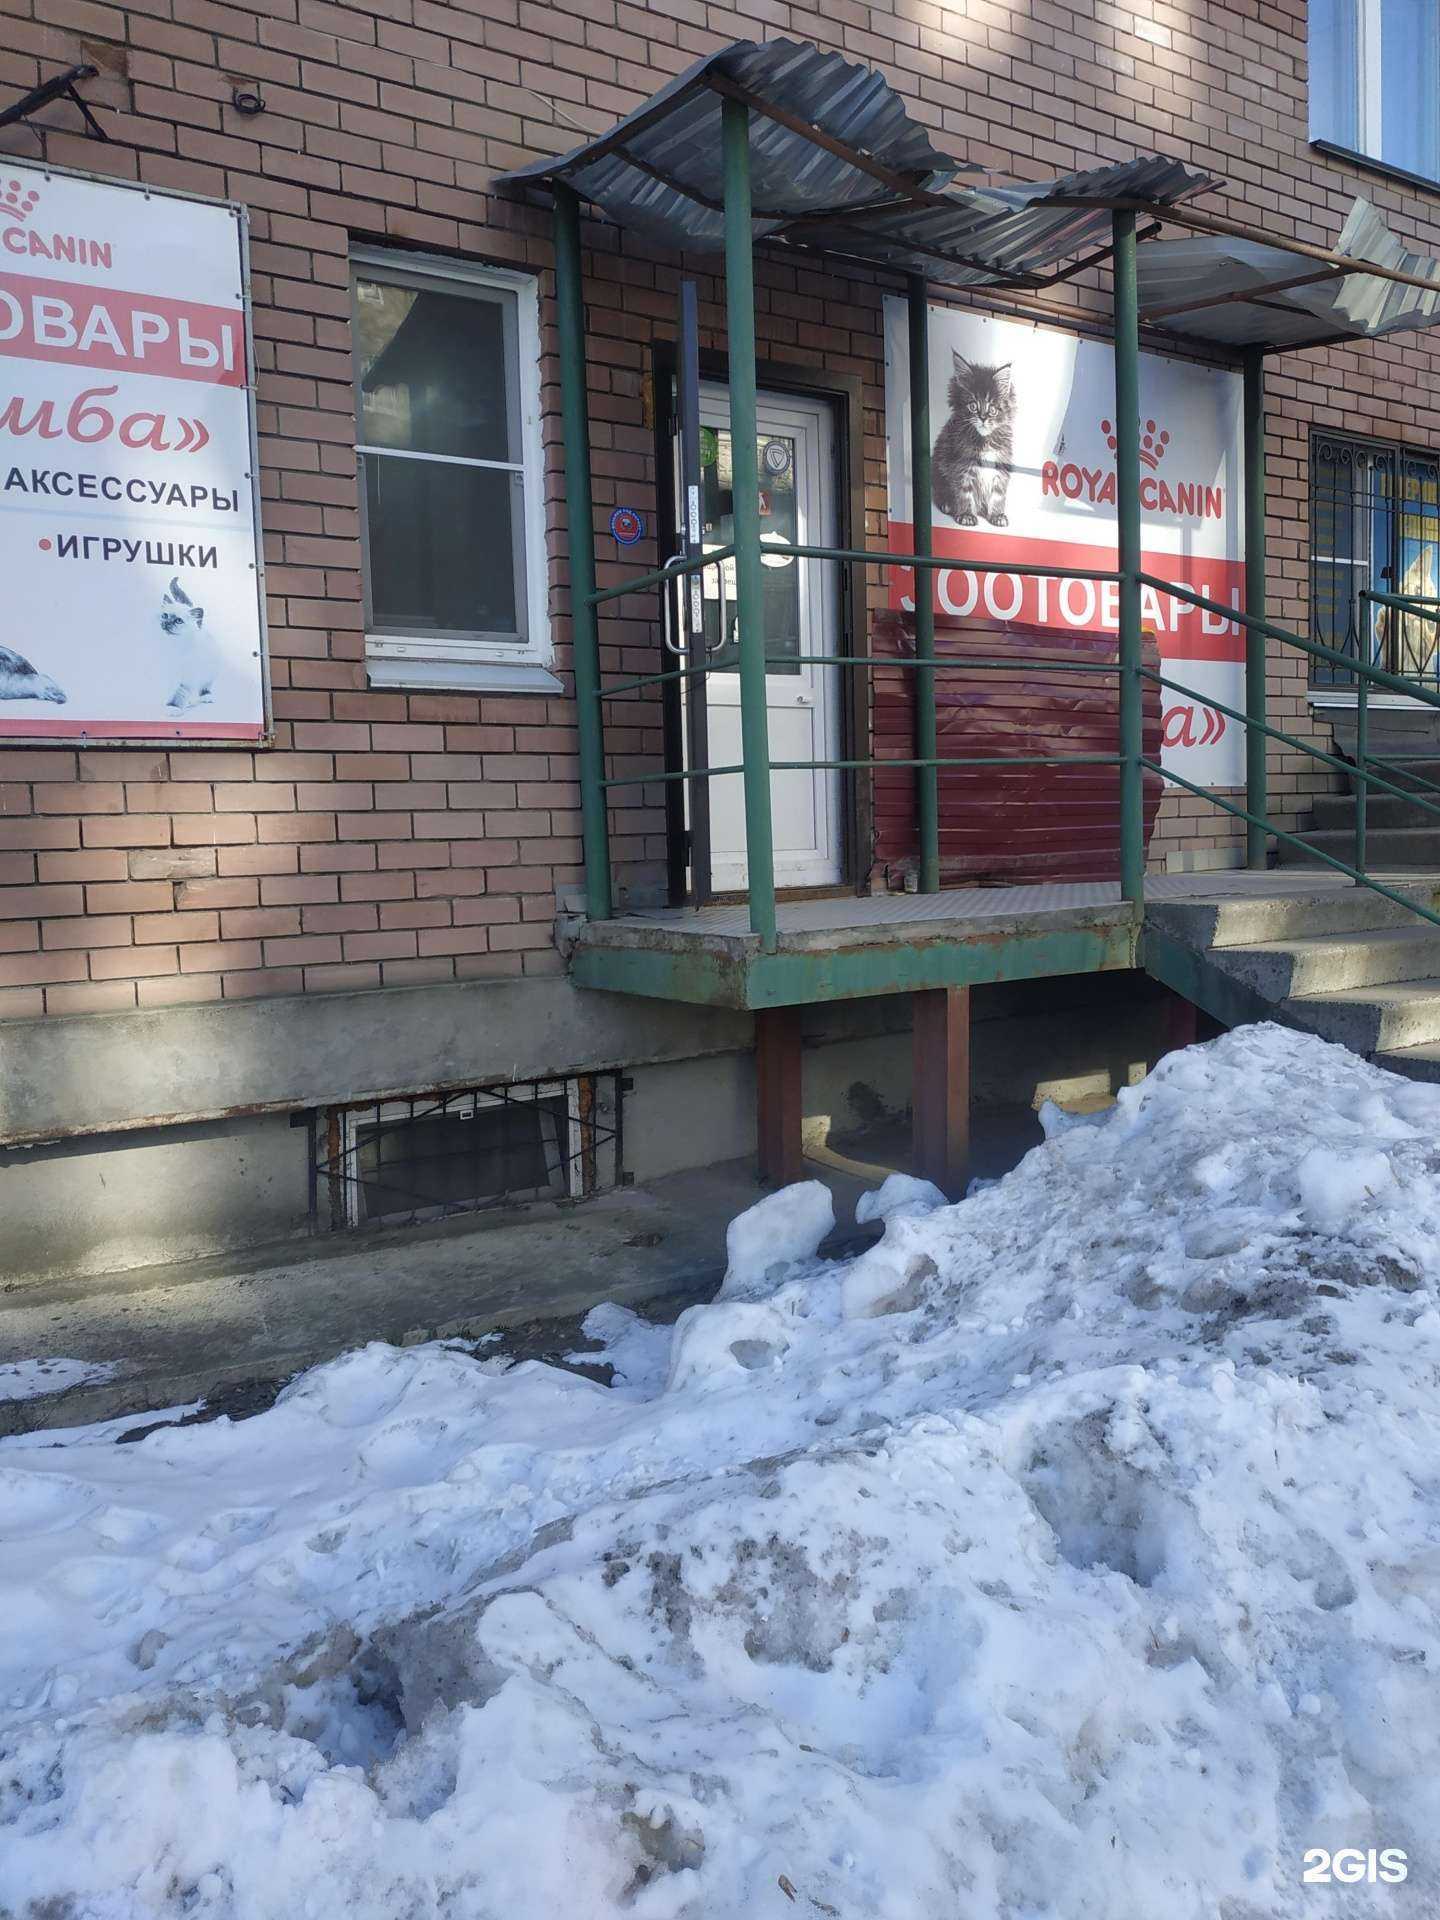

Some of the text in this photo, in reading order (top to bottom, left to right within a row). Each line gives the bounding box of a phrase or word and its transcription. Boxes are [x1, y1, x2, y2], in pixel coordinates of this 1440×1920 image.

[2, 227, 112, 269] CANIN
[4, 467, 239, 512] АКСЕССУАРЫ
[1041, 460, 1222, 519] ROYA CANIN
[57, 534, 218, 568] ИГРУШКИ
